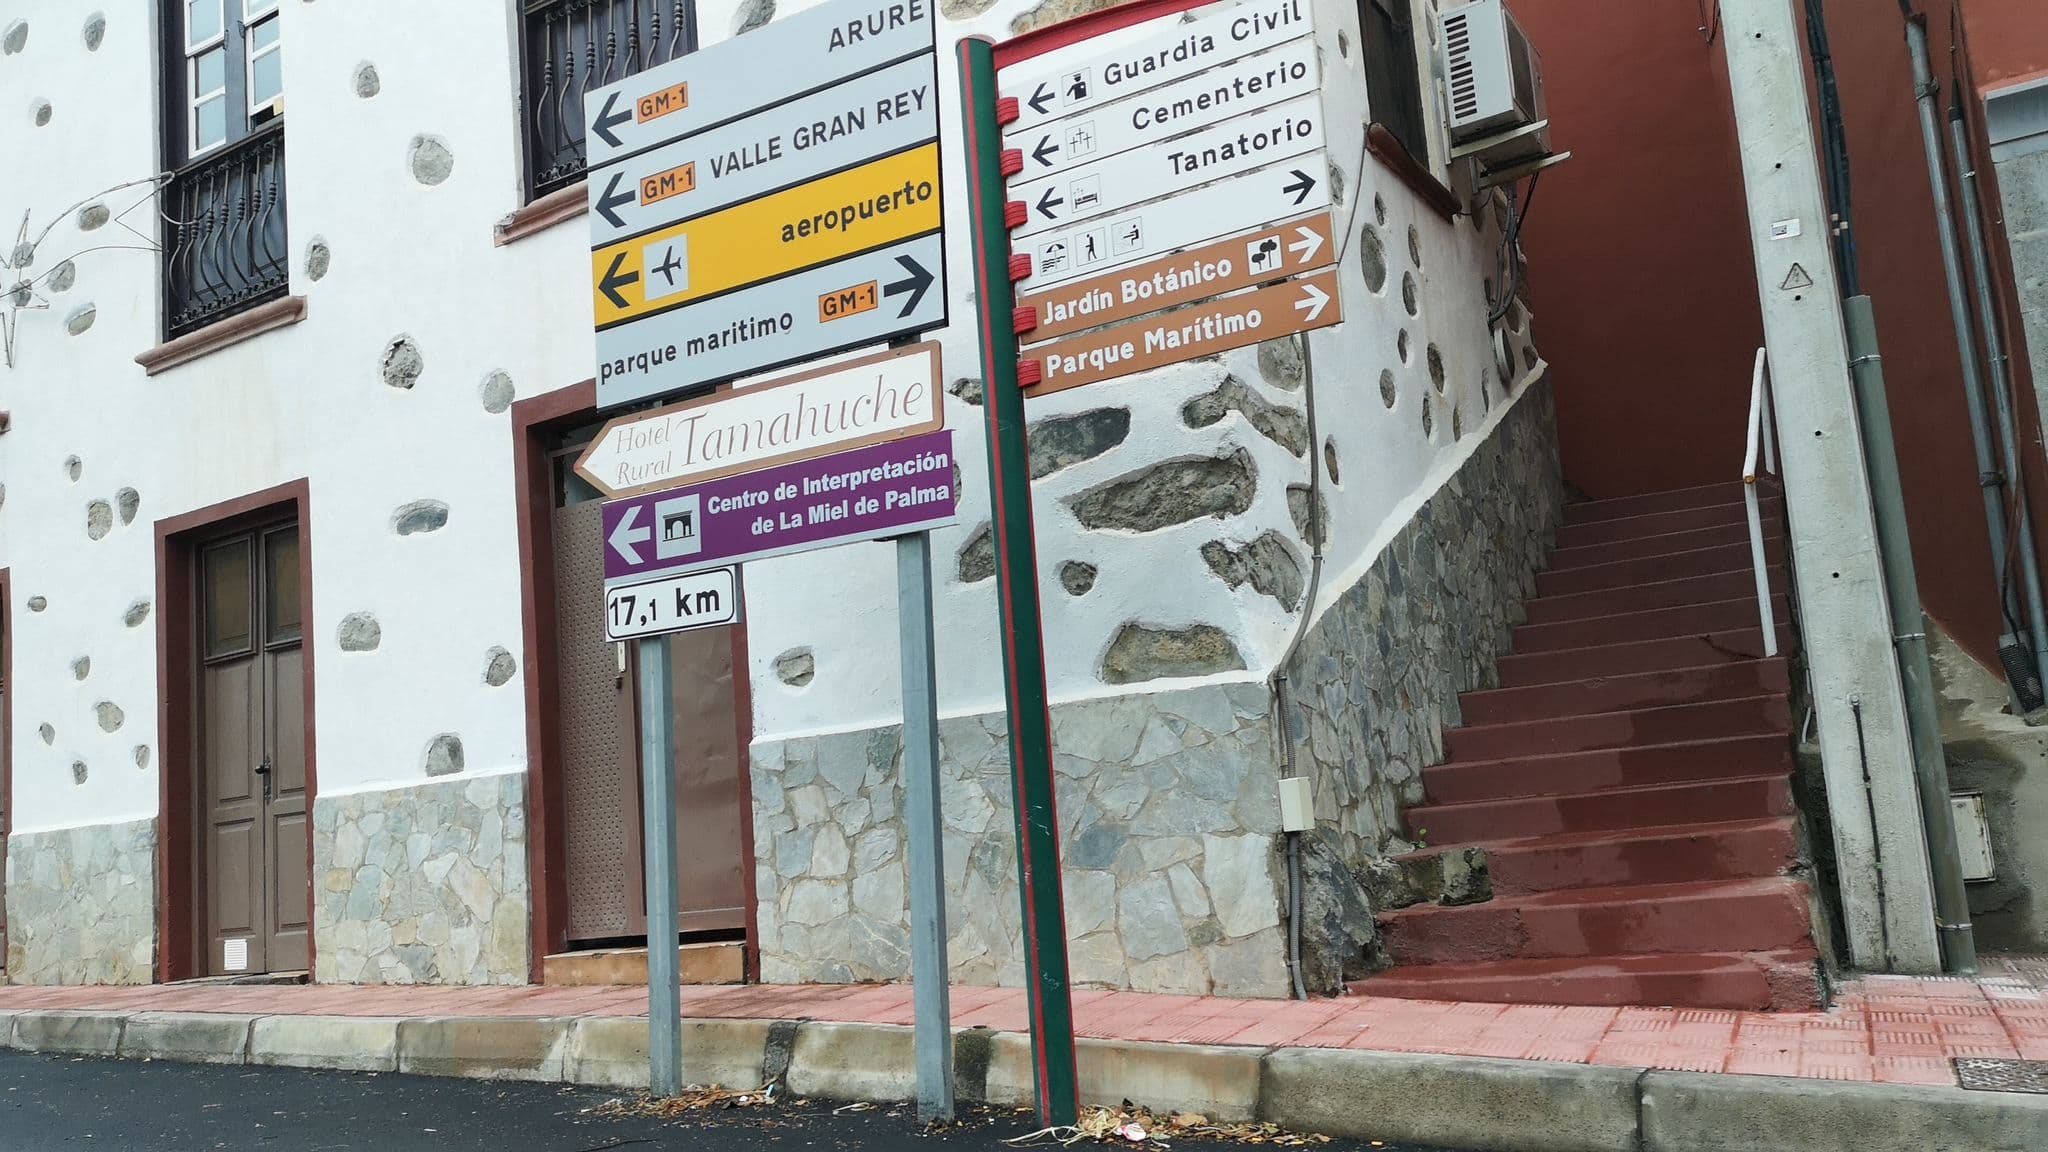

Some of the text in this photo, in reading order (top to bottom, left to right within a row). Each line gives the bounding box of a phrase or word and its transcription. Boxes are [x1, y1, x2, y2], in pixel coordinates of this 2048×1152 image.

[829, 0, 925, 52] ARURE
[1104, 0, 1302, 86] Guardia Civil
[640, 86, 687, 117] GM-1
[1132, 61, 1306, 130] Cementerio
[644, 86, 927, 200] GM-1 VALLE GRAN REY
[1168, 118, 1312, 175] Tanatorio
[781, 180, 932, 243] aeropuerto
[1043, 258, 1233, 325] Jardín Botánico
[601, 285, 876, 385] parque maritimo GM-1
[1046, 308, 1262, 378] Parque Marítimo
[616, 416, 670, 454] Hotel
[674, 374, 924, 466] Tamahuche
[616, 450, 672, 485] Rural
[708, 451, 948, 515] Centro de Interpretación
[751, 484, 950, 536] de La Miel de Palma
[609, 587, 720, 627] 17,1 km
